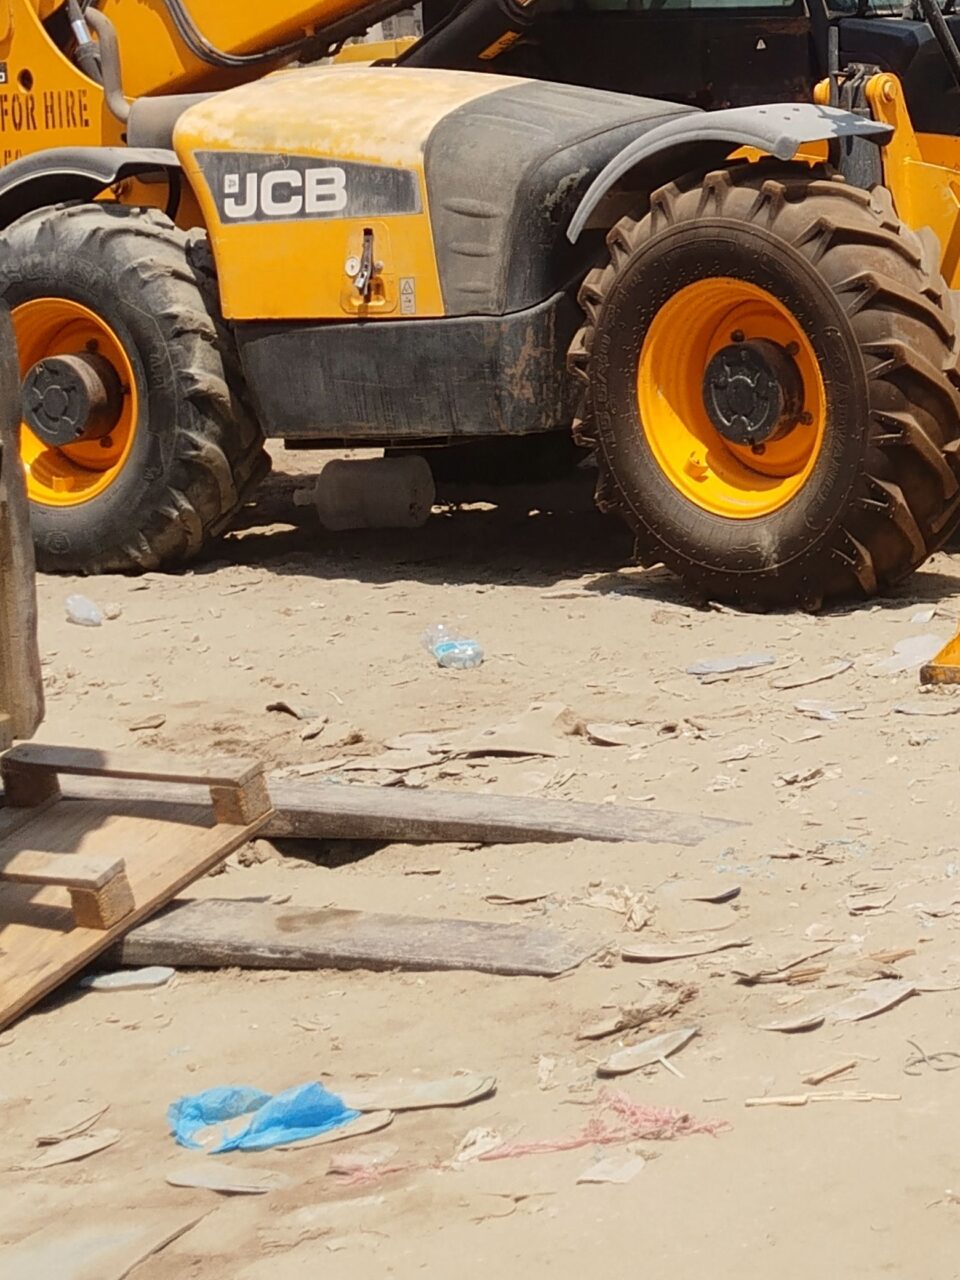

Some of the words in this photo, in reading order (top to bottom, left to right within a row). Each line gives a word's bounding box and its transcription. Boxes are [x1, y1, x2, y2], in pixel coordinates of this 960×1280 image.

[0, 93, 37, 132] FOR
[43, 89, 90, 130] HIRE
[224, 166, 348, 219] JCB
